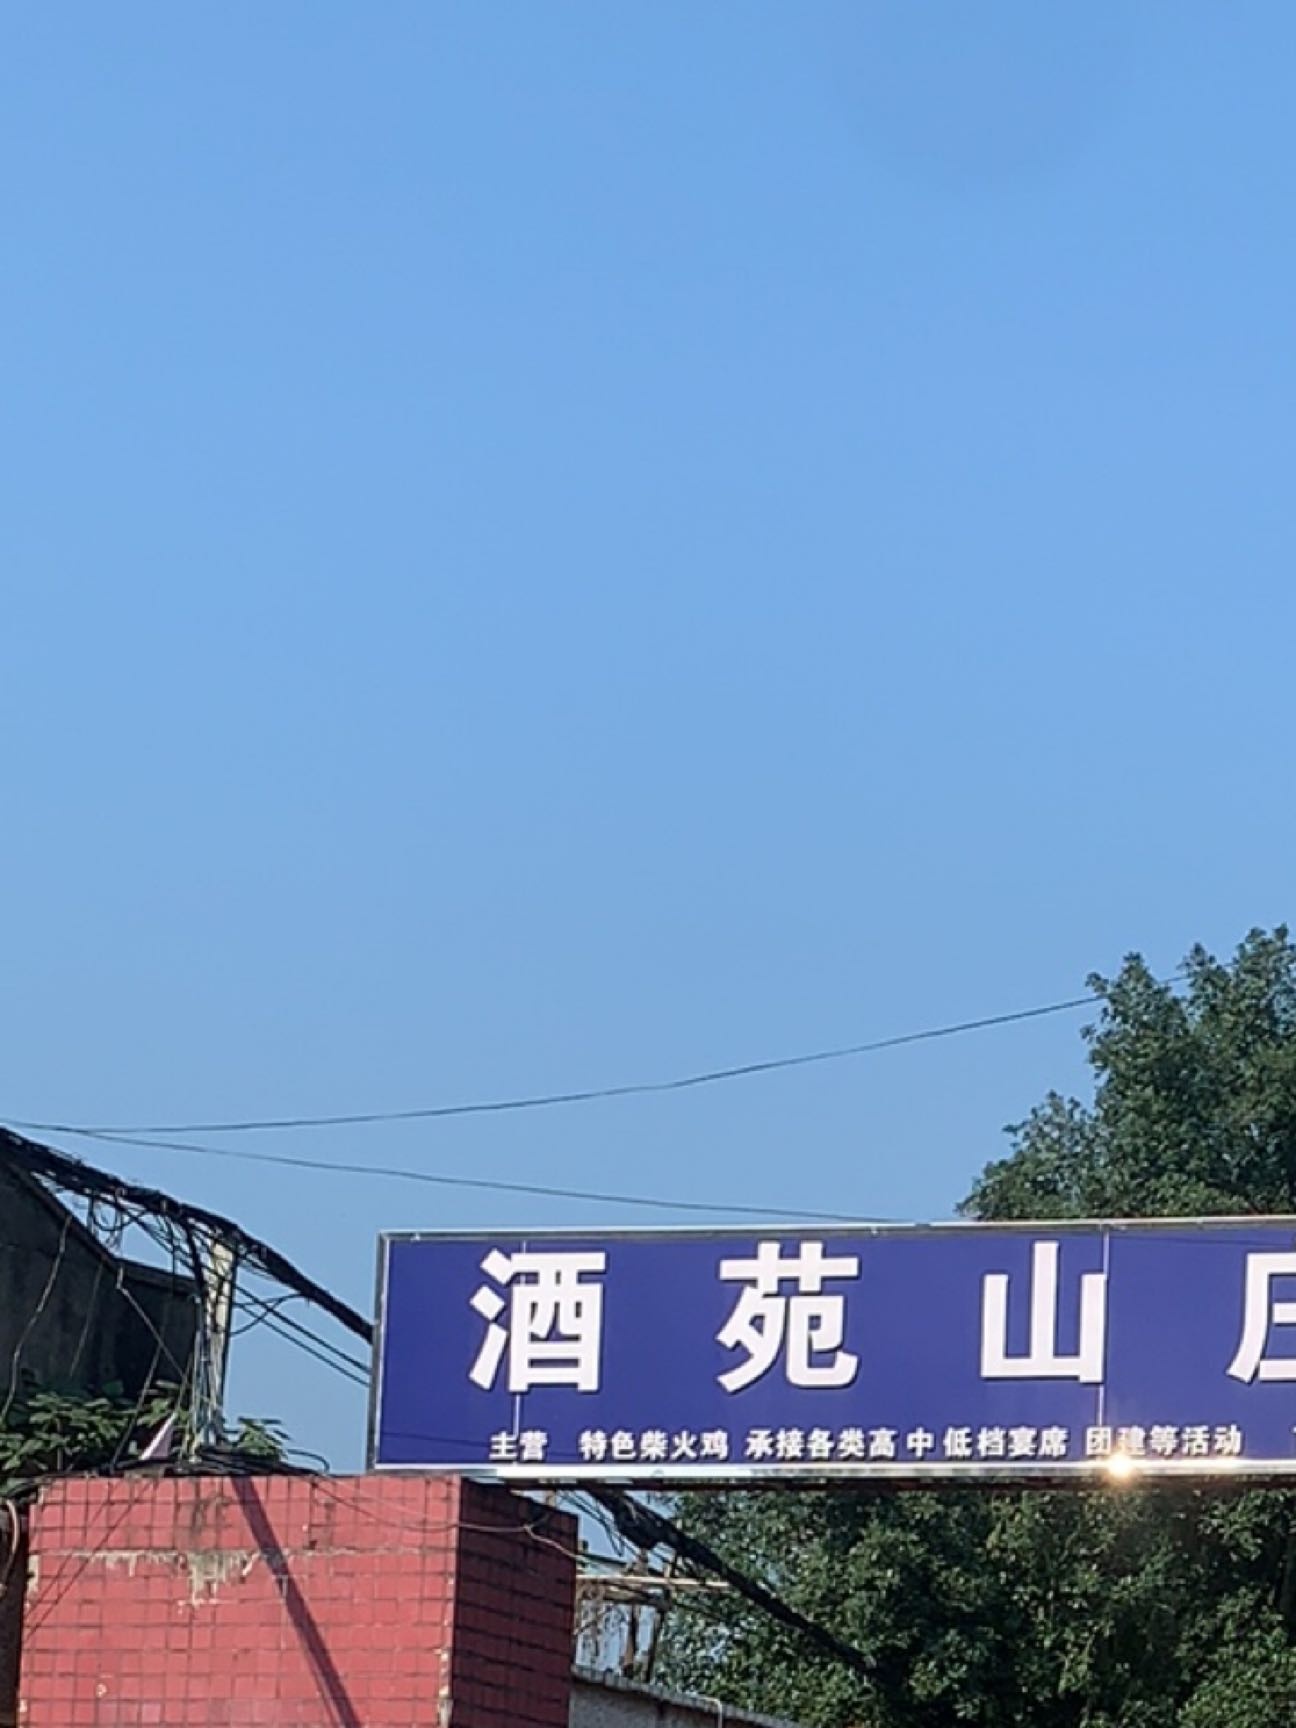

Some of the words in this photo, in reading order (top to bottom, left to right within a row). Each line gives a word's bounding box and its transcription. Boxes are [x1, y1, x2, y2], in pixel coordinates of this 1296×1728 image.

[489, 1430, 548, 1461] 主营
[578, 1430, 729, 1461] 特色柴火鸡
[1086, 1424, 1242, 1456] 团建等活动
